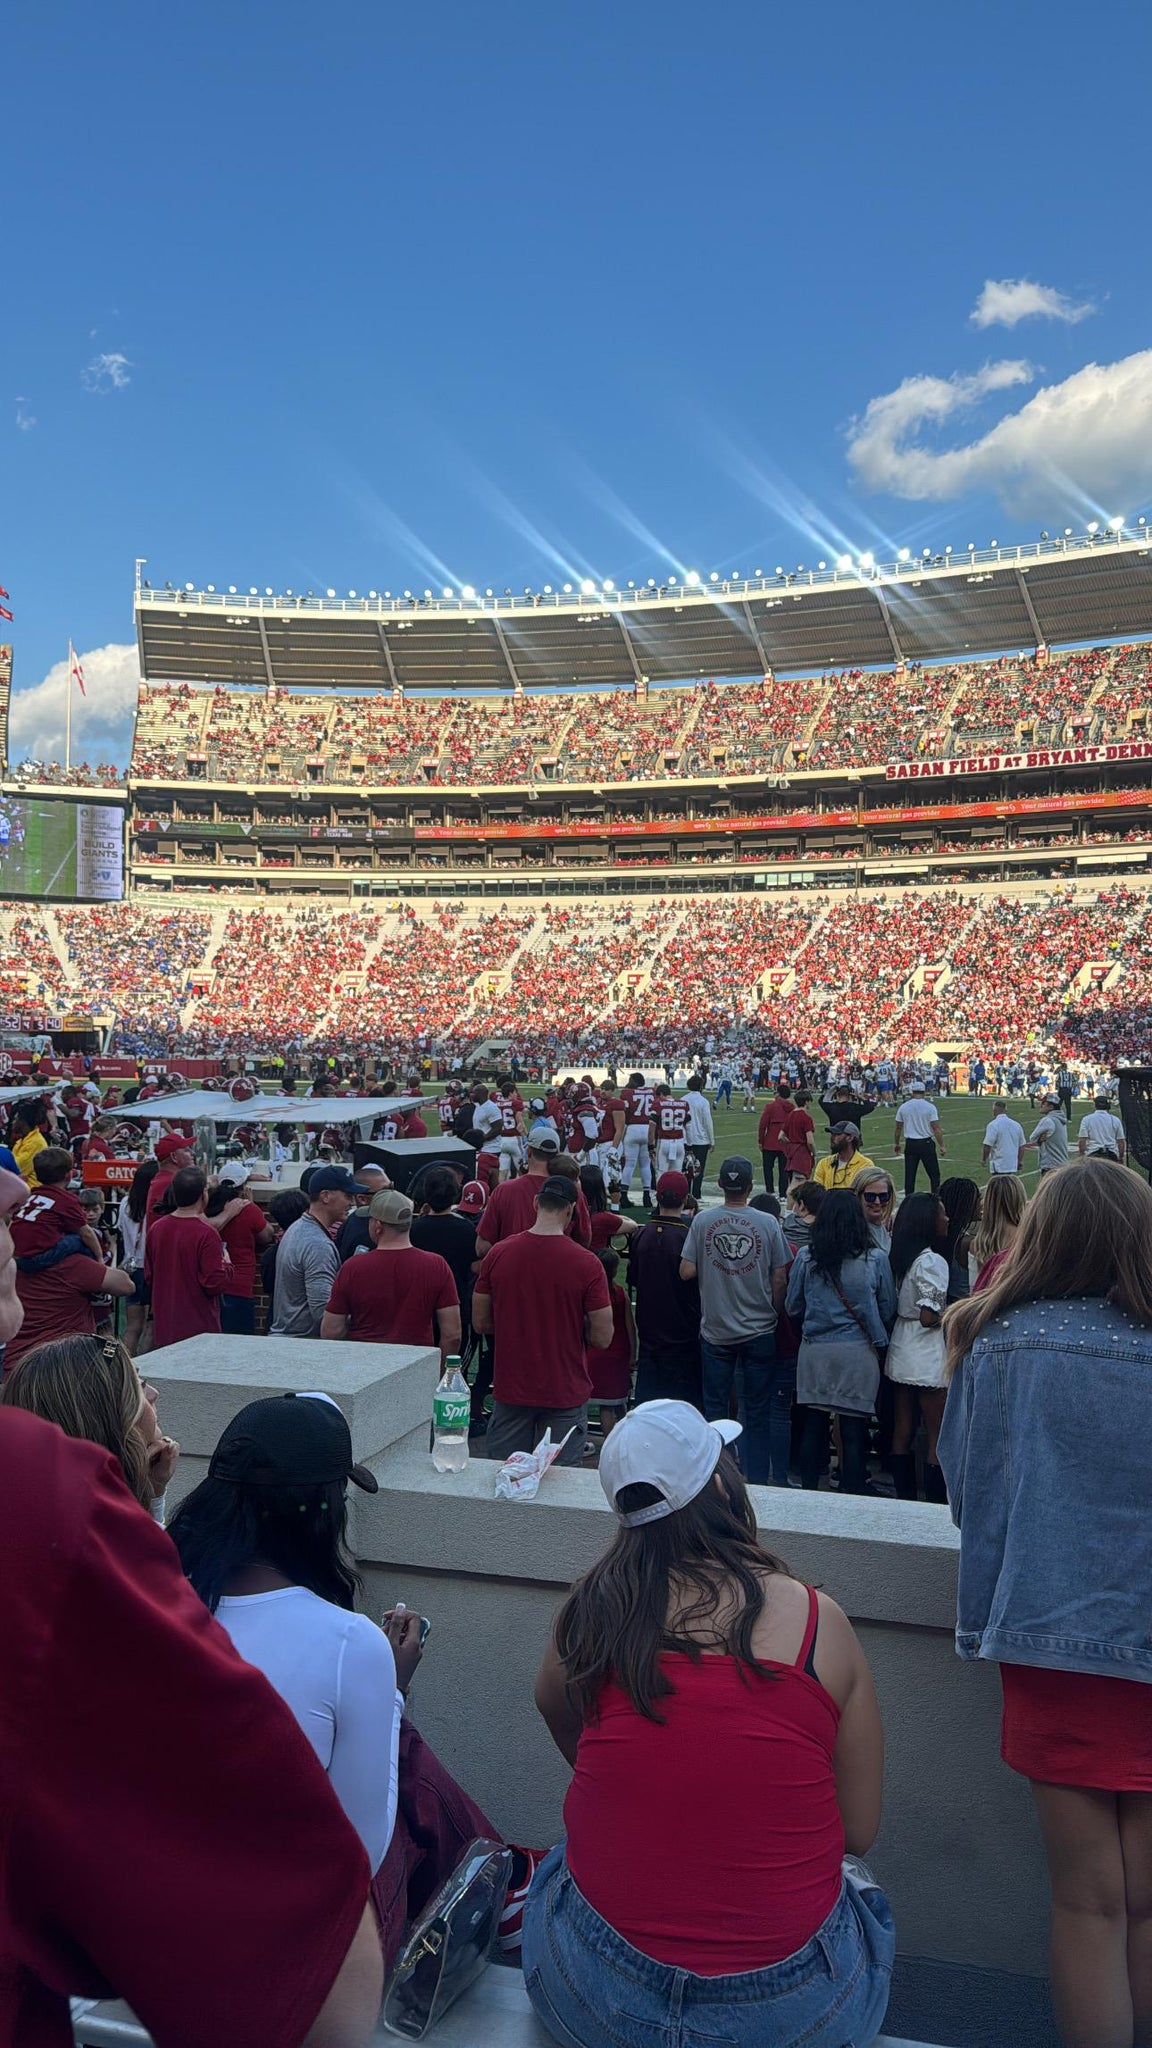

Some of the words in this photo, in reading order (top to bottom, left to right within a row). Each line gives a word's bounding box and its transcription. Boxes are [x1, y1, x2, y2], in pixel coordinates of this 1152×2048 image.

[886, 762, 944, 779] SABAN
[949, 757, 1000, 774] FIELD
[1004, 756, 1022, 768] AT
[81, 849, 118, 858] GIANTS
[84, 841, 115, 849] BUILD
[661, 1108, 686, 1131] 82
[706, 1217, 739, 1241] UNIVERSITY
[751, 1227, 762, 1259] ALABAMA
[713, 1260, 740, 1276] CRIMSON
[740, 1262, 756, 1274] TIDE
